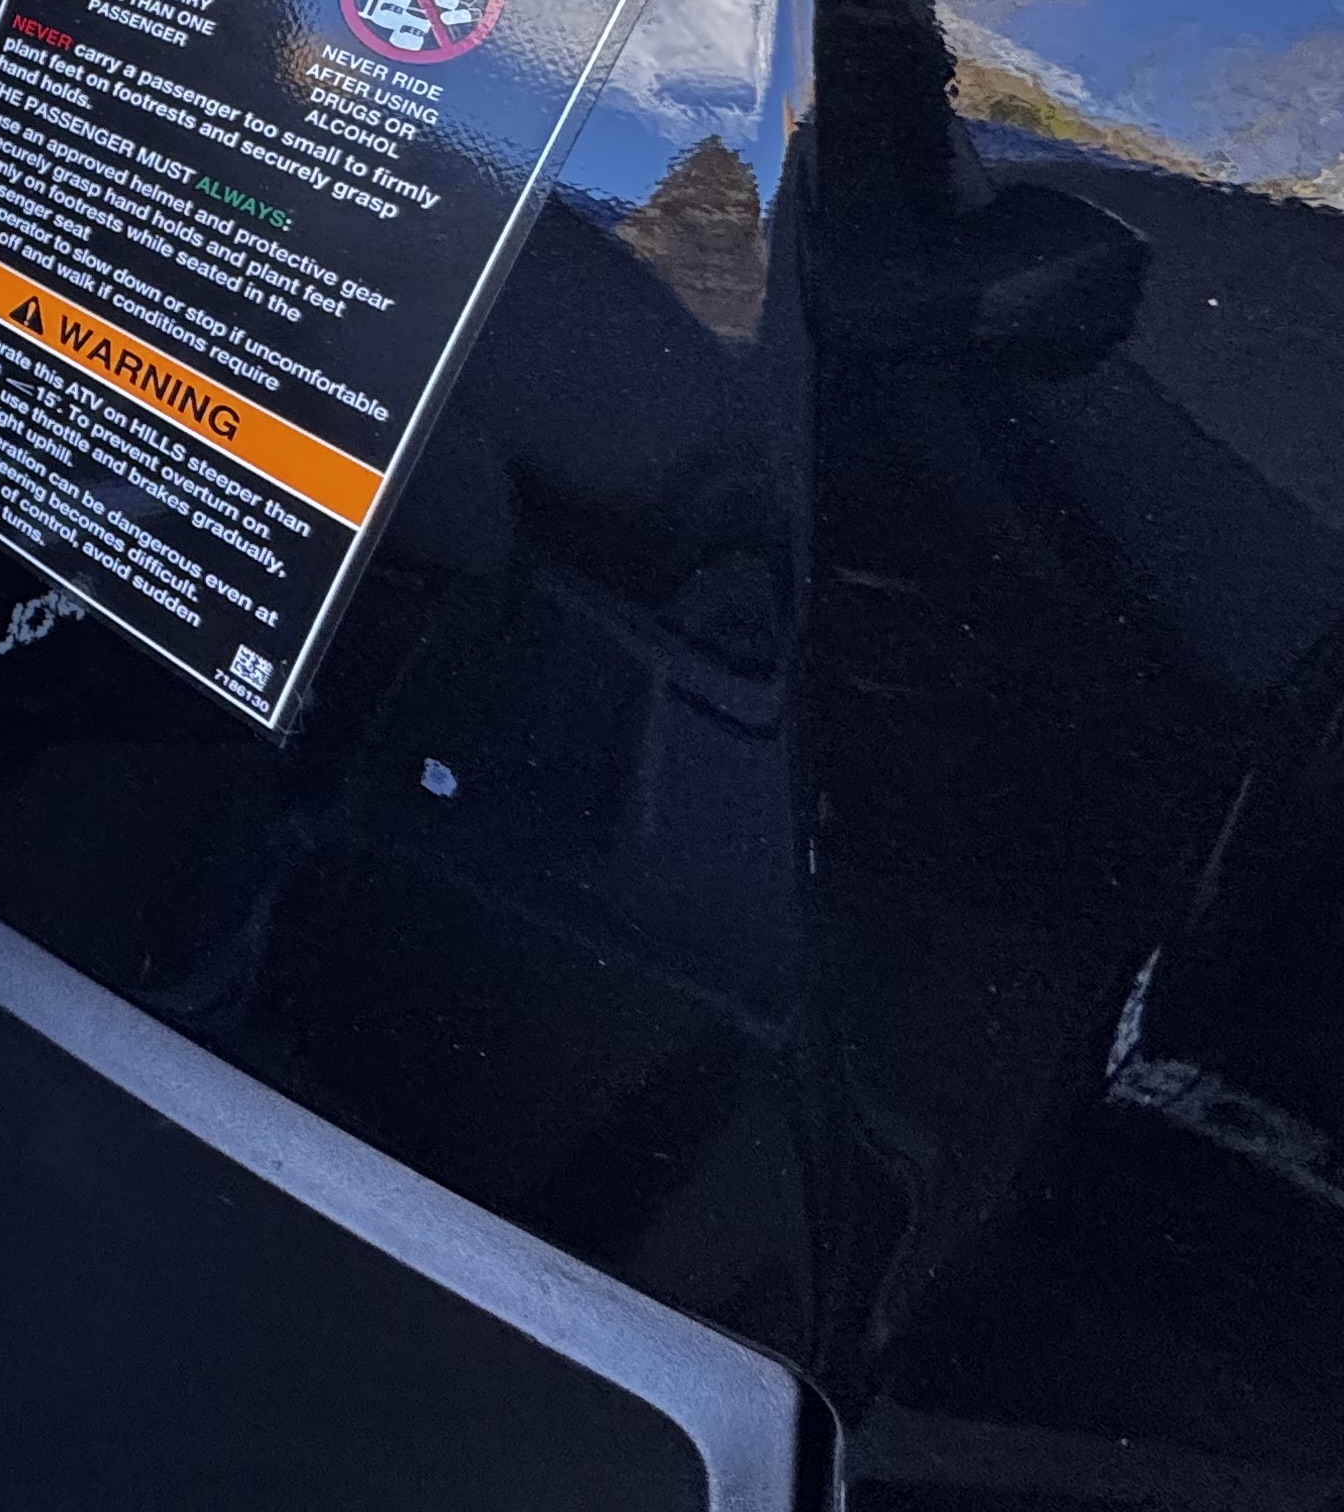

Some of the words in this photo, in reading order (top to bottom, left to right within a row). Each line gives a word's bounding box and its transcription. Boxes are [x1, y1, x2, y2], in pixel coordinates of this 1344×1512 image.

[176, 10, 217, 36] ONE
[321, 44, 389, 82] NEVER
[391, 71, 445, 103] RIDE
[2, 37, 49, 65] plant
[48, 54, 85, 81] feet
[85, 73, 111, 93] on
[112, 81, 197, 130] footrests
[198, 122, 241, 148] and
[240, 140, 332, 190] securely
[331, 181, 399, 219] grasp
[12, 14, 72, 50] NEVER
[74, 44, 123, 74] carry
[122, 64, 137, 79] a
[137, 70, 243, 122] passenger
[243, 111, 279, 139] too
[281, 131, 343, 166] small
[343, 154, 368, 177] to
[372, 166, 441, 210] firmly
[39, 74, 92, 110] holds.
[304, 63, 371, 99] AFTER
[373, 87, 441, 126] USING
[304, 109, 400, 159] ALCOHOL
[309, 86, 382, 126] DRUGS
[384, 117, 420, 141] OR
[22, 127, 45, 146] an
[46, 138, 130, 185] approved
[129, 174, 194, 217] helmet
[194, 209, 235, 236] and
[233, 228, 339, 286] protective
[339, 279, 395, 311] gear
[23, 95, 135, 158] PASSENGER
[135, 146, 197, 184] MUST
[196, 177, 293, 232] ALWAYS:
[52, 214, 92, 242] seat
[23, 175, 47, 195] on
[48, 184, 124, 233] footrests
[126, 225, 175, 258] while
[175, 250, 244, 292] seated
[243, 281, 264, 304] in
[267, 294, 302, 322] the
[51, 165, 103, 198] grasp
[103, 186, 152, 221] hand
[151, 209, 204, 248] holds
[205, 240, 247, 268] and
[245, 260, 301, 295] plant
[302, 284, 346, 318] feet
[21, 244, 56, 270] and
[57, 262, 96, 293] walk
[97, 281, 114, 300] if
[112, 293, 209, 352] conditions
[209, 345, 280, 391] require
[53, 234, 72, 255] to
[72, 248, 113, 275] slow
[112, 268, 162, 303] down
[163, 295, 187, 313] or
[184, 306, 228, 337] stop
[228, 326, 247, 345] if
[244, 338, 389, 422] uncomfortable
[60, 314, 240, 442] WARNING
[0, 389, 30, 415] use
[31, 407, 91, 453] throttle
[91, 447, 128, 476] and
[127, 466, 191, 516] brakes
[191, 510, 286, 578] gradually,
[25, 428, 73, 468] uphill.
[33, 361, 65, 390] this
[64, 382, 104, 411] ATV
[103, 406, 128, 428] on
[129, 418, 187, 462] HILLS
[187, 456, 263, 507] steeper
[264, 499, 311, 537] than
[68, 403, 90, 429] To
[90, 423, 160, 472] prevent
[161, 466, 240, 521] overturn
[242, 515, 270, 540] on
[0, 485, 20, 503] of
[19, 498, 79, 548] control,
[82, 541, 133, 580] avoid
[132, 574, 201, 627] sudden
[1, 505, 45, 546] turns.
[48, 491, 126, 553] becomes
[127, 547, 198, 603] difficult.
[48, 472, 80, 499] can
[81, 490, 105, 515] be
[106, 510, 203, 579] dangerous
[205, 573, 253, 611] even
[254, 605, 279, 628] at
